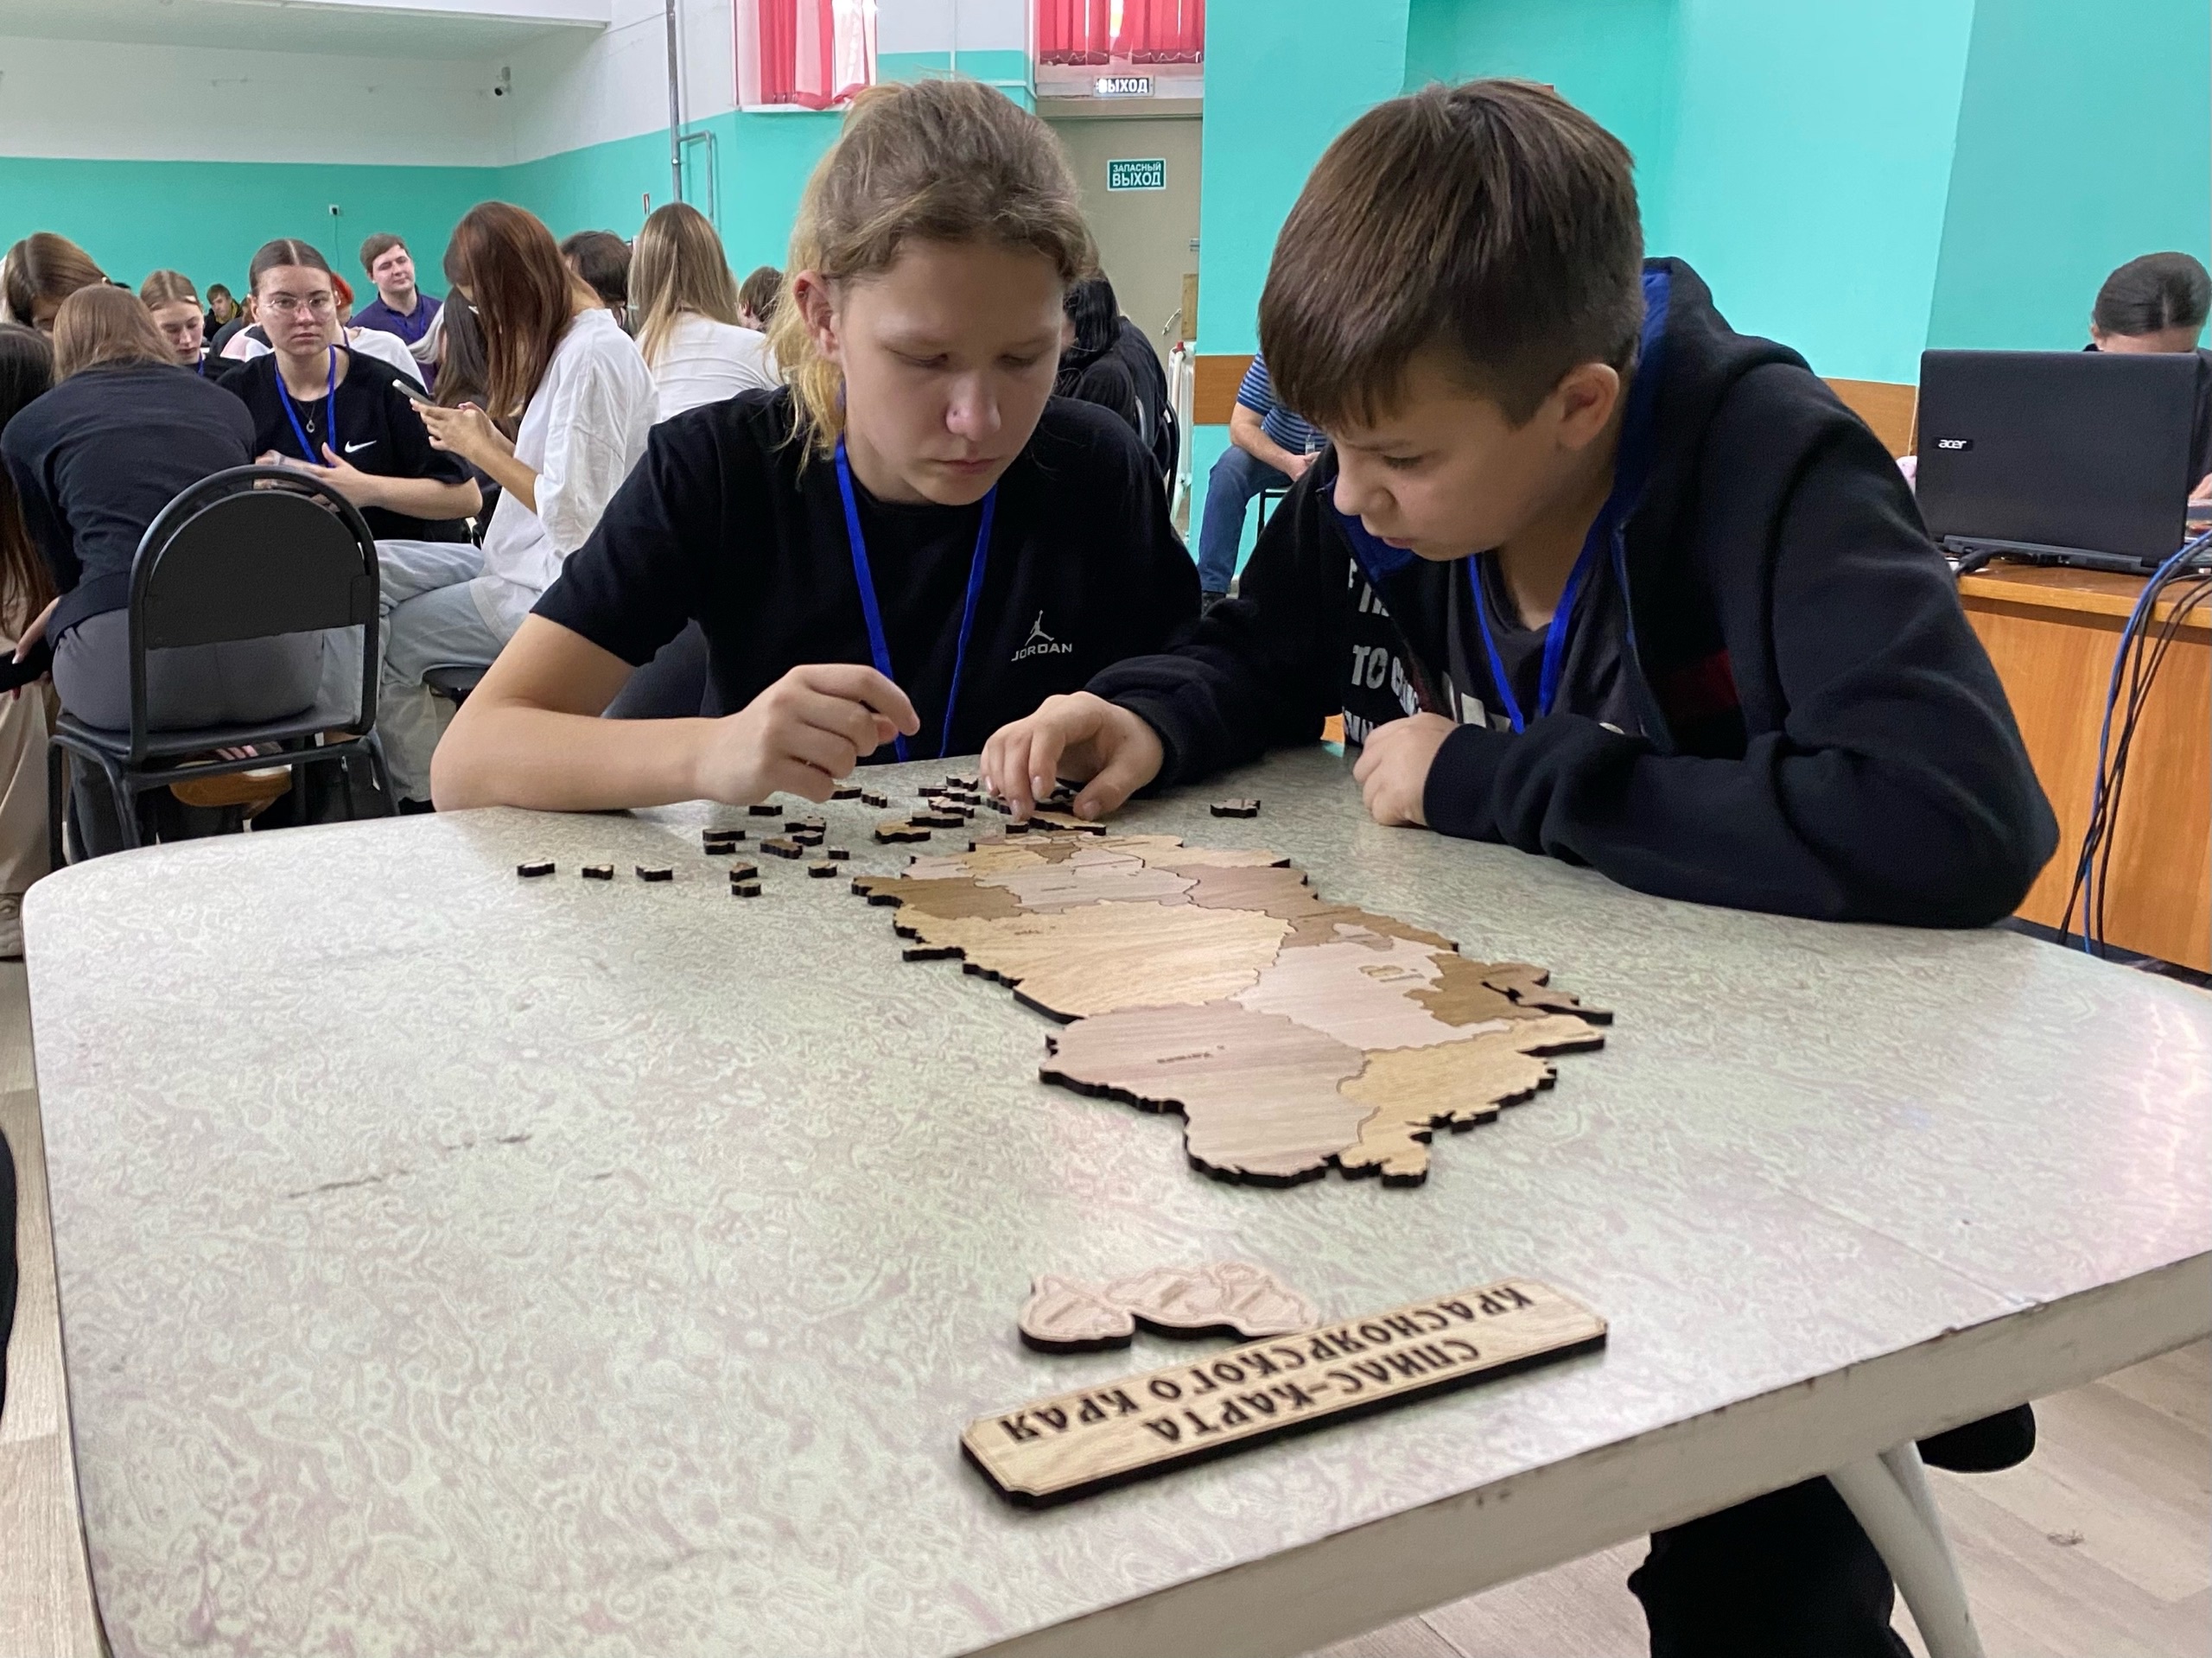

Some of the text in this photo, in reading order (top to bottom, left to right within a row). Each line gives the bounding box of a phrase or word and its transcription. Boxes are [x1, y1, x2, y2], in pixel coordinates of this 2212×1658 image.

[1113, 162, 1161, 173] ЗАПАСНЫЙ
[1112, 172, 1161, 187] ВЫХОД
[1938, 439, 1967, 449] acer
[1011, 643, 1072, 662] JORDAN
[1000, 1286, 1535, 1444] КРАСНОЯРСКОГО КРАЯ
[1142, 1339, 1481, 1443] СПИЛС-КАРТА
